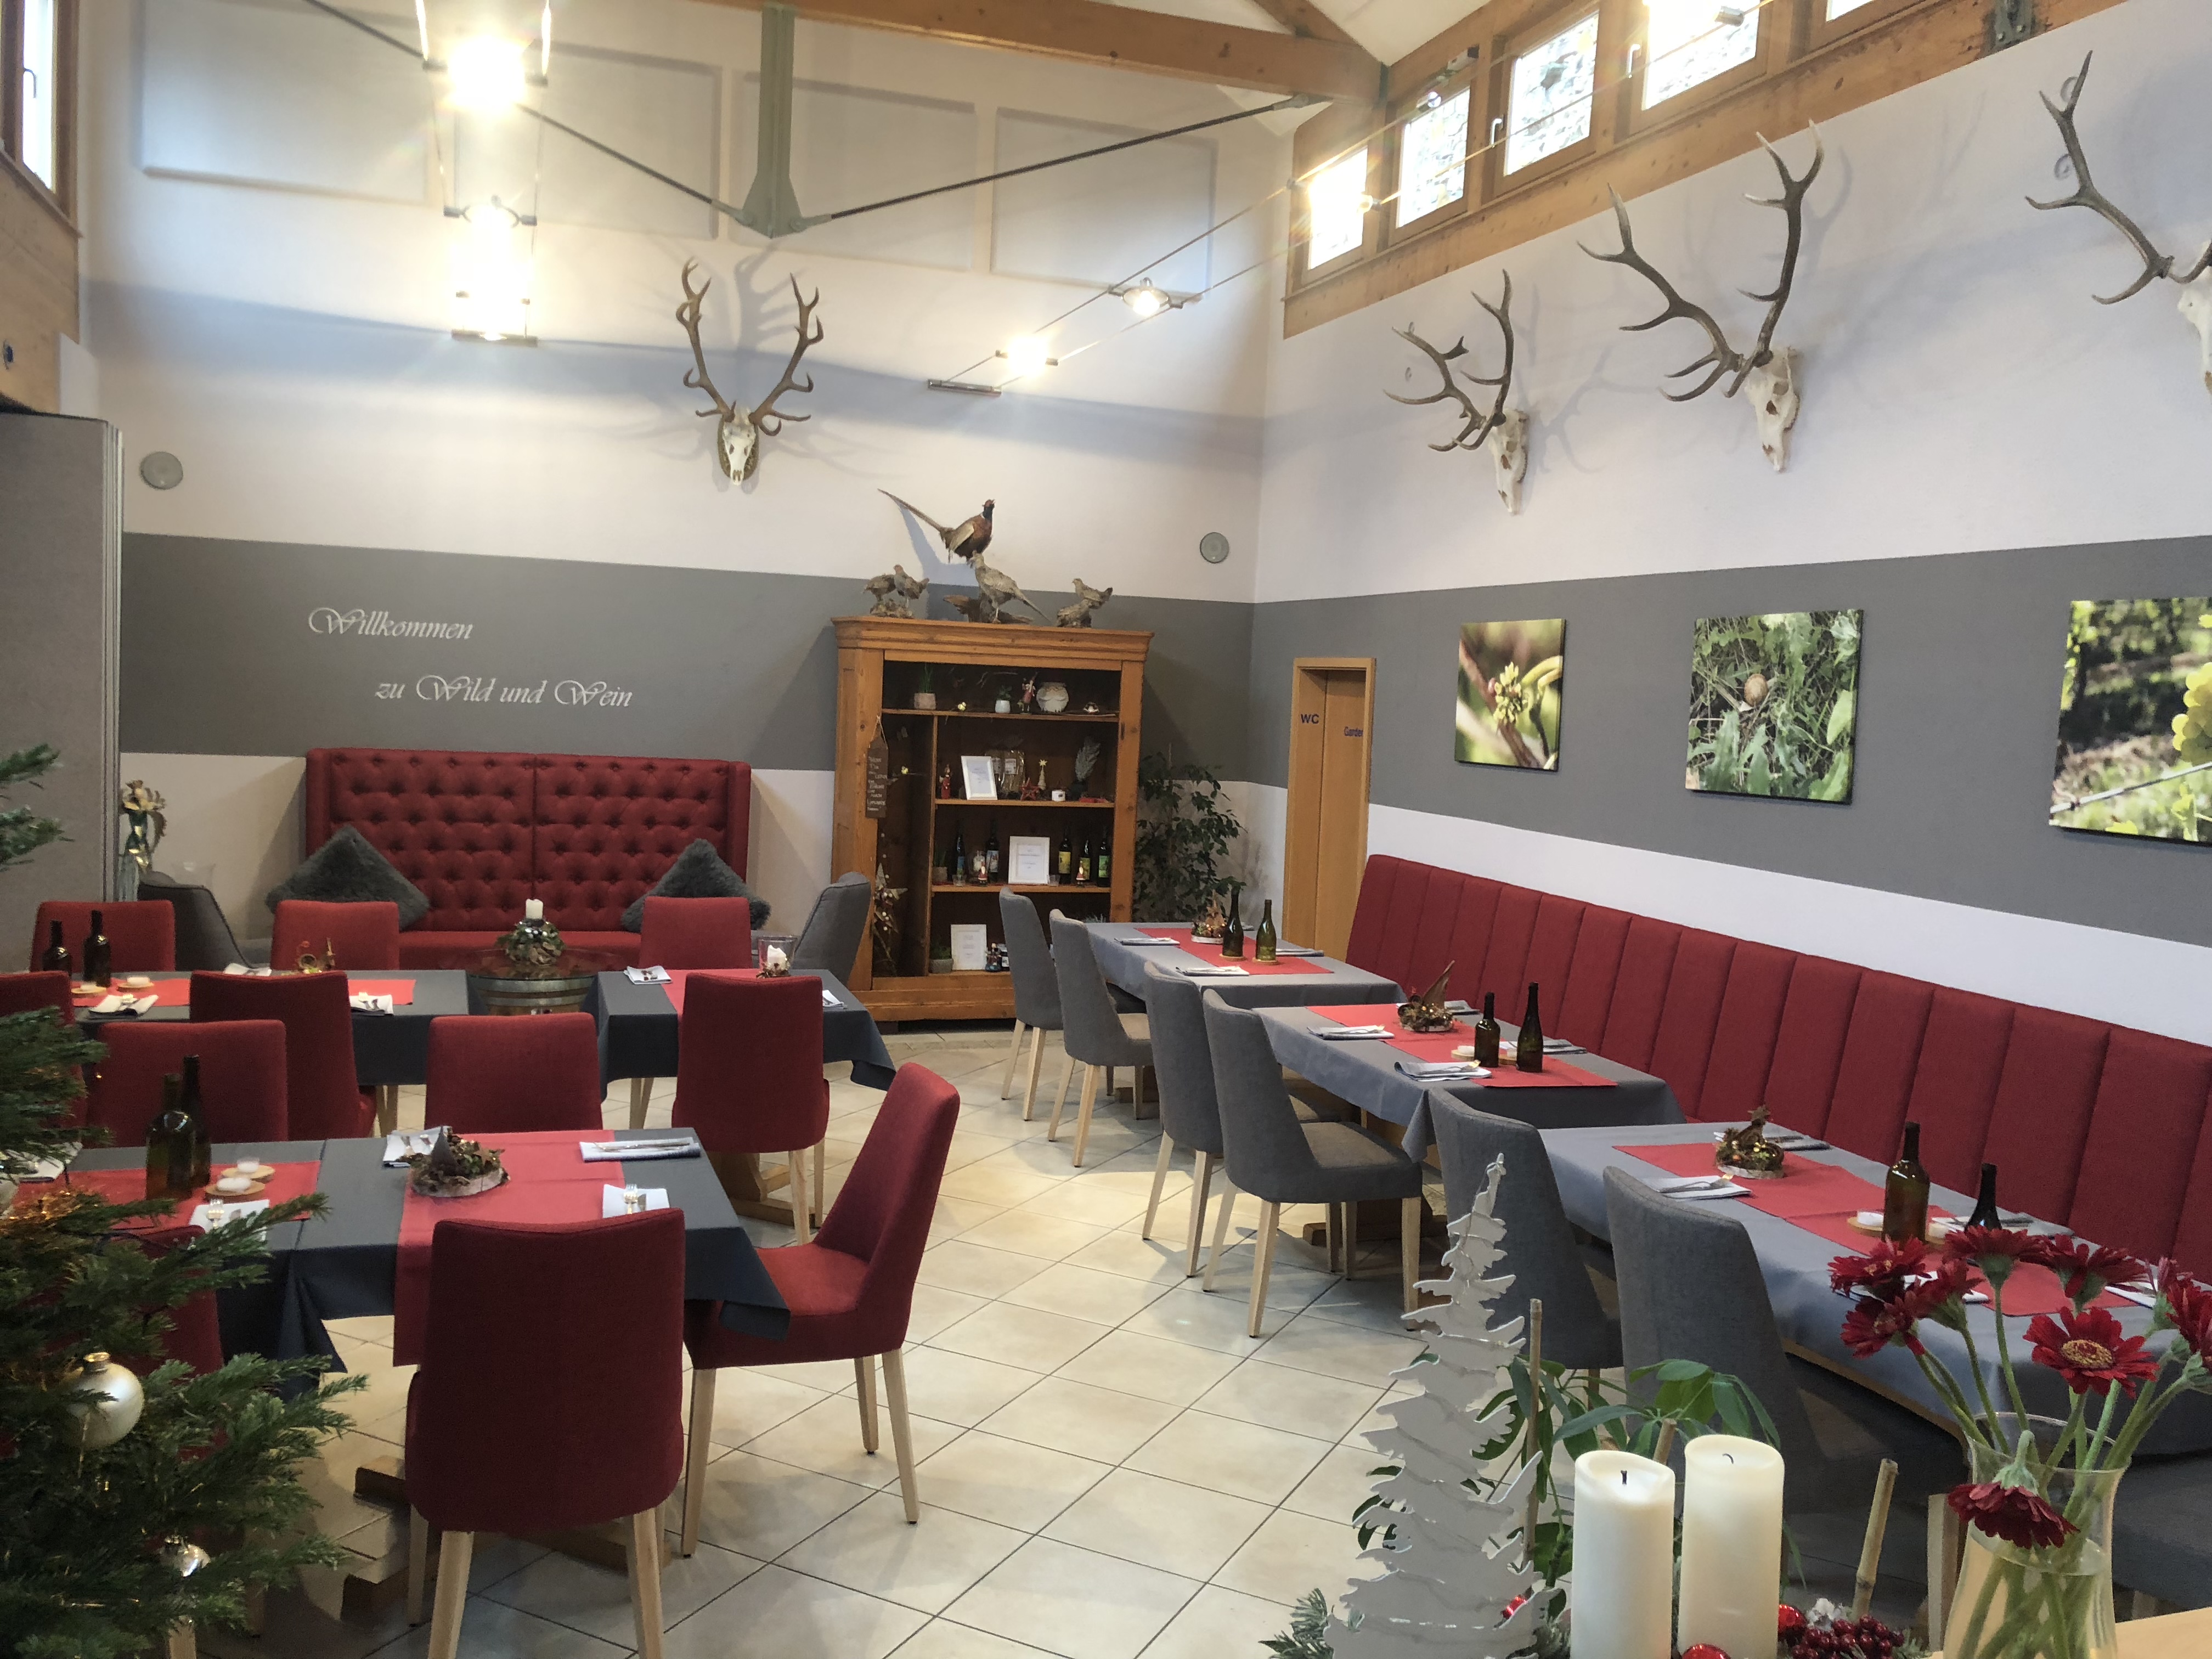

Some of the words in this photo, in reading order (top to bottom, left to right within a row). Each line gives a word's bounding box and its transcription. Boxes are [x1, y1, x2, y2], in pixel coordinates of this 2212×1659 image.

[308, 607, 473, 639] Willkommen
[375, 682, 405, 699] zu
[416, 674, 496, 703] Wild
[499, 680, 548, 704] und
[554, 680, 633, 707] Wein
[1301, 714, 1319, 724] WC
